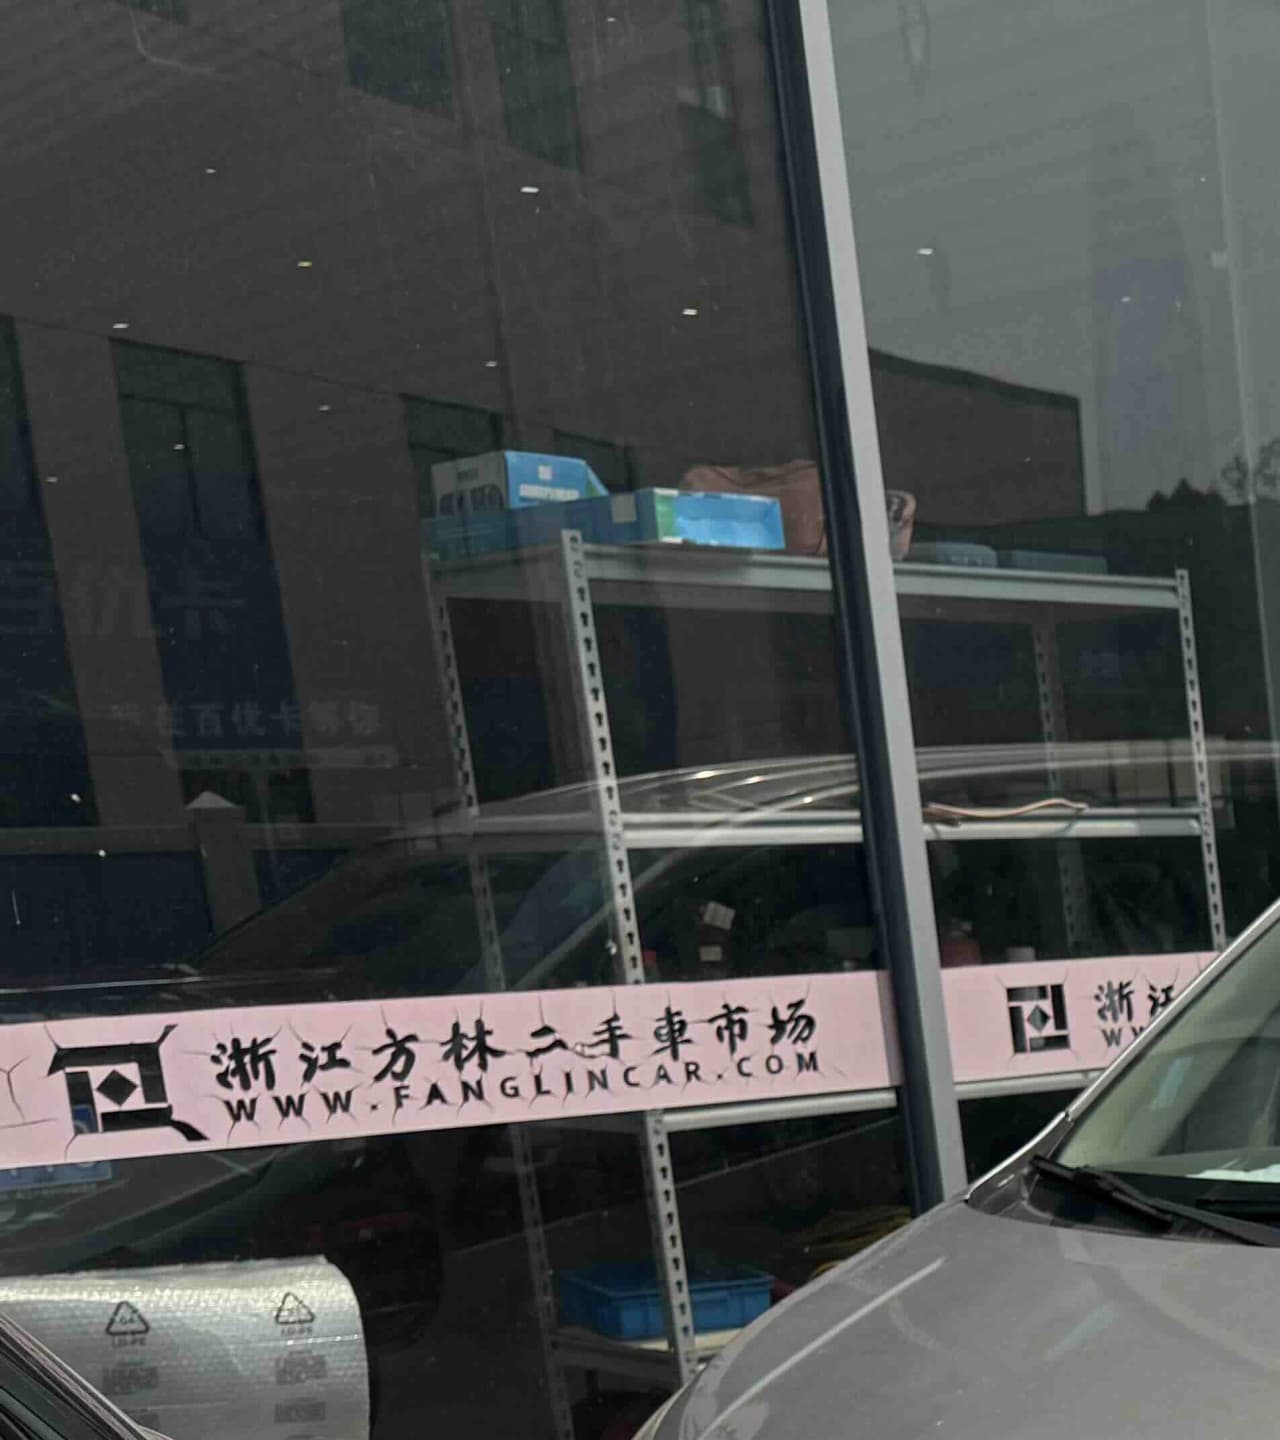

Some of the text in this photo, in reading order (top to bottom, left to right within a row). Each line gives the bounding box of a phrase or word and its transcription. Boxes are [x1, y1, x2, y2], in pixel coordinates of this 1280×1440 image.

[211, 998, 817, 1091] 浙江方林二手車市场
[224, 1051, 819, 1122] WWW.FANGLINCAR.COM
